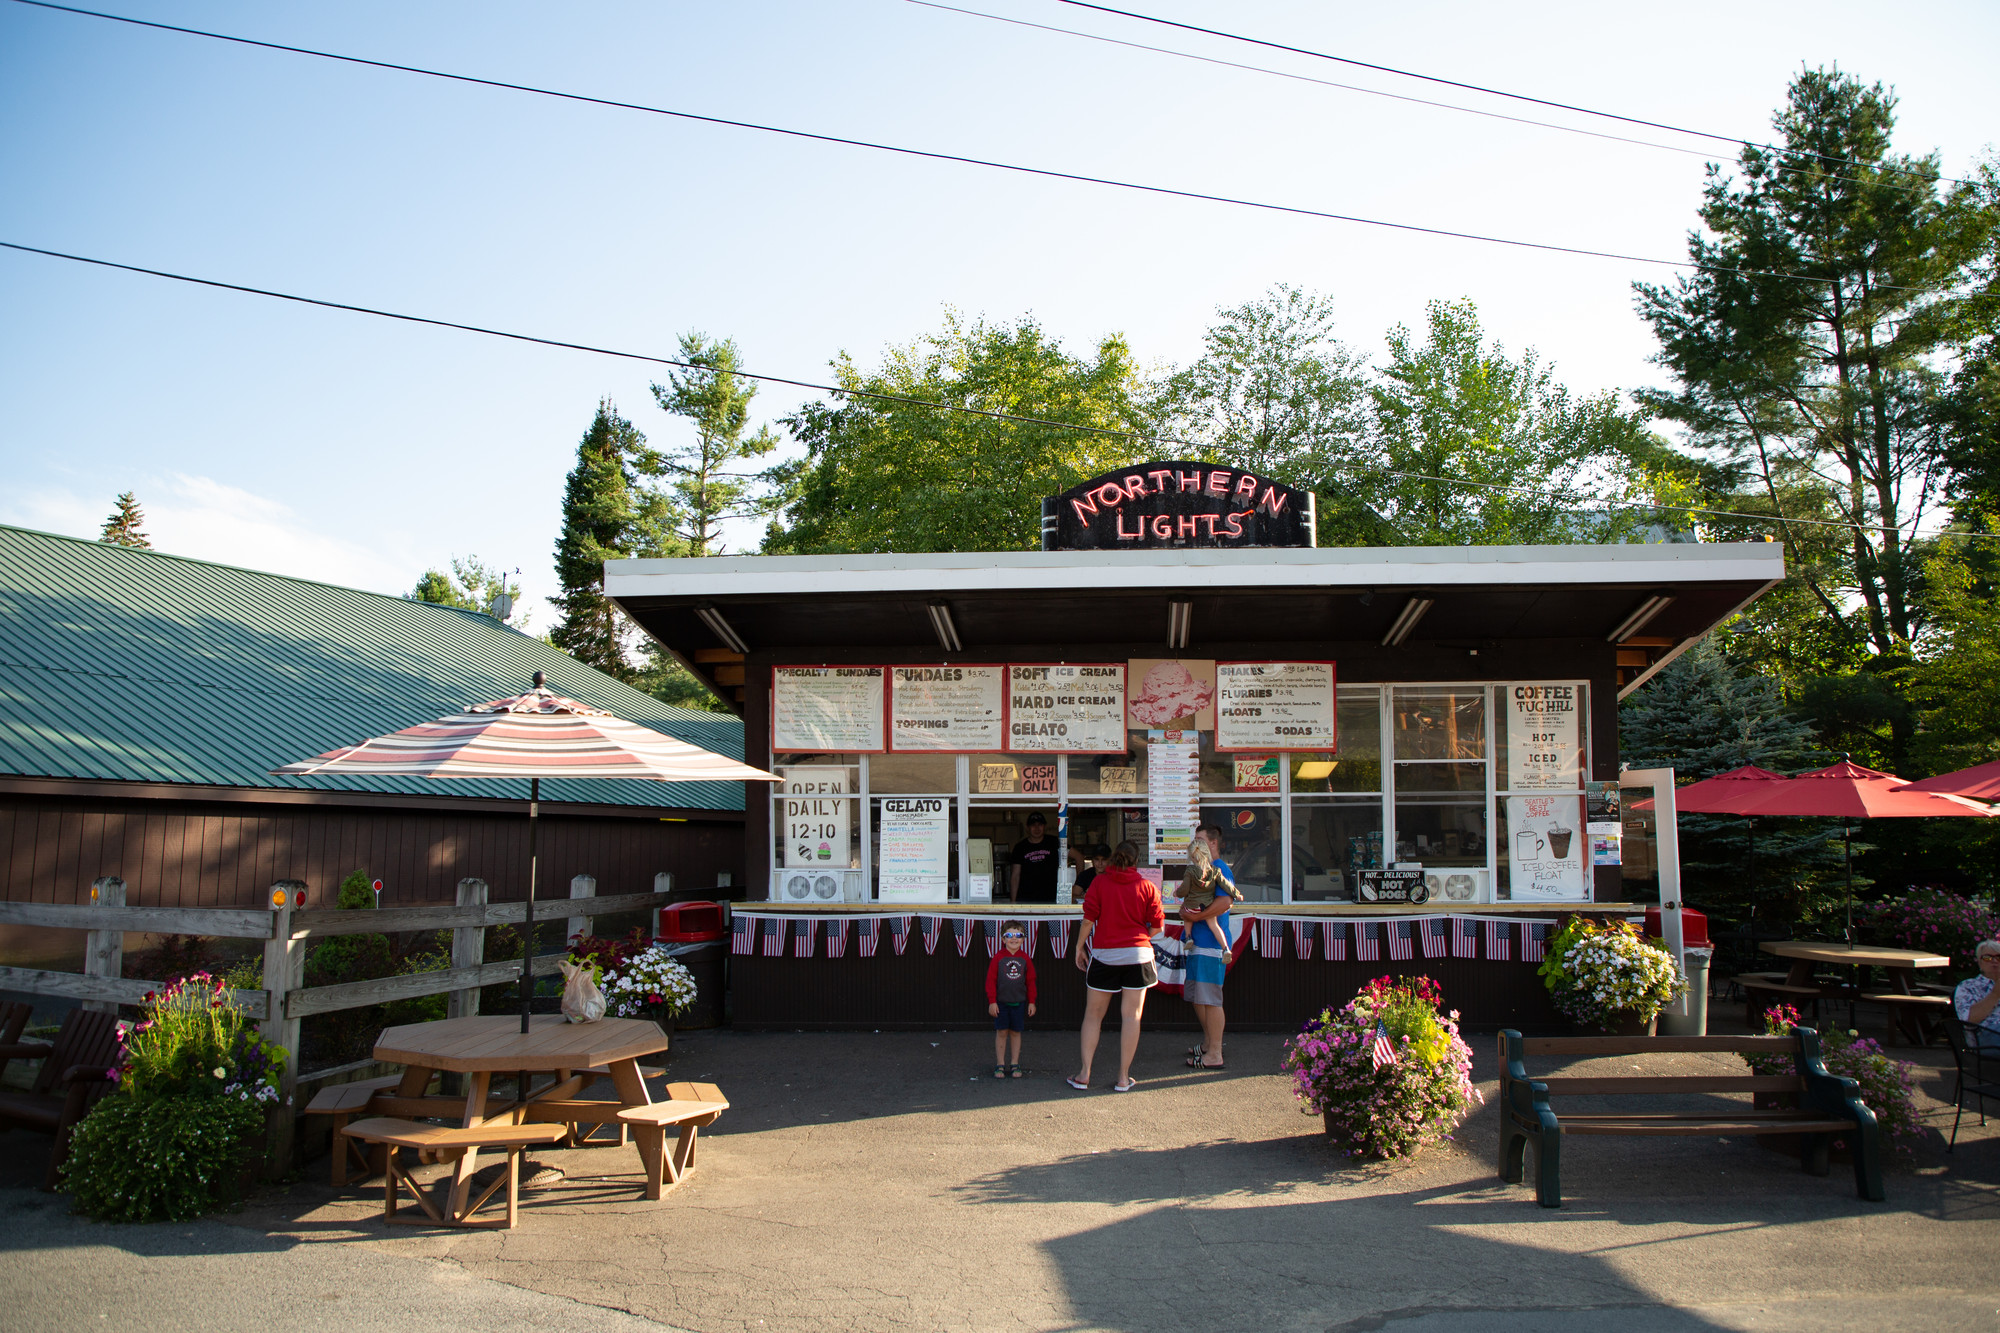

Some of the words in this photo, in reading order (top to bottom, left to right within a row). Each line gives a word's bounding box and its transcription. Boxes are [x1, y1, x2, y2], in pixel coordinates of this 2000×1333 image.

[1072, 470, 1286, 527] NORTHERN
[1117, 512, 1249, 540] LIGHTS
[836, 668, 882, 677] SUNDAES
[896, 668, 963, 681] SUNDAES
[1013, 667, 1050, 680] SOFT
[1056, 668, 1074, 676] ICE
[1080, 668, 1116, 676] CREAM
[1221, 667, 1264, 676] SHAKES
[1222, 689, 1272, 699] FLURRIES
[1515, 686, 1573, 699] COFFEE
[1013, 696, 1054, 708] HARD
[1517, 701, 1544, 713] TUG
[1546, 700, 1574, 712] HILL
[1222, 708, 1261, 717] FLOATS
[896, 720, 949, 729] TOPPINGS
[1012, 723, 1067, 736] GELATO
[1275, 726, 1312, 736] SODAS
[1532, 733, 1556, 741] HOT
[1529, 754, 1557, 762] ICED
[979, 766, 1013, 778] PICK-UP
[1023, 767, 1055, 779] CASH
[1101, 768, 1135, 781] ORDER
[1237, 763, 1266, 775] HOT
[981, 779, 1012, 791] HERE
[1023, 779, 1056, 792] ONLY
[1245, 774, 1277, 787] DOGS
[792, 782, 842, 794] OPEN
[1103, 781, 1134, 793] HERE
[885, 800, 942, 812] GELATO
[1525, 796, 1555, 806] SEATTLE'S
[788, 800, 841, 816] DAILY
[1526, 810, 1550, 818] COFFEE
[1529, 804, 1550, 812] BEST
[791, 823, 836, 839] 12-10
[1522, 863, 1545, 871] ICED
[1546, 861, 1579, 869] COFFEE
[1534, 870, 1560, 880] FLOAT
[1381, 880, 1404, 889] HOT
[1531, 882, 1557, 892] $4.50
[1379, 890, 1407, 899] DOGS
